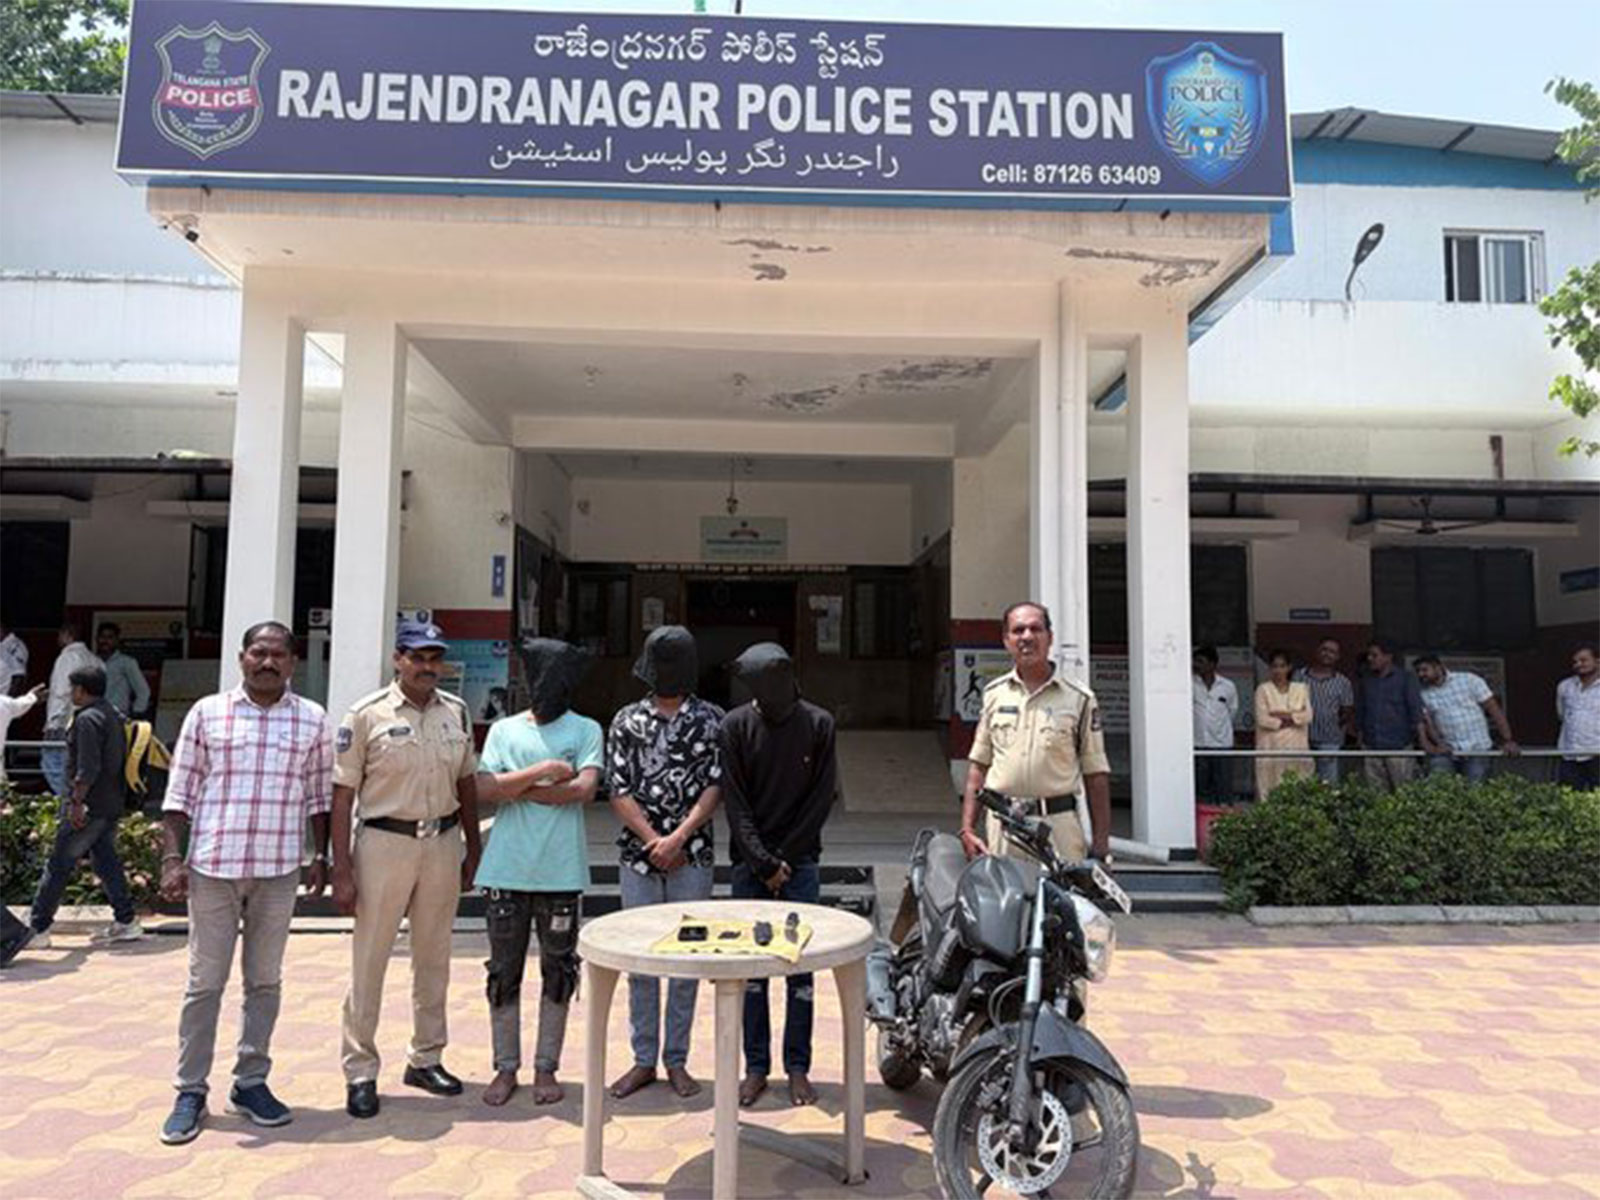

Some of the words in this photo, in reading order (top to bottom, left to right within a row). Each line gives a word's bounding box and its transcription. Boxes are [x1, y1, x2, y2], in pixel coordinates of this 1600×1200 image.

[721, 30, 797, 64] పోలీస్
[809, 31, 886, 79] స్టేషన్
[166, 85, 253, 108] POLICE
[277, 68, 721, 130] RAJENDRANAGAR
[737, 83, 913, 138] POLICE
[928, 88, 1134, 140] STATION
[1169, 86, 1242, 101] POLICE
[490, 136, 612, 170] اسٹیشن
[625, 139, 727, 175] پولیس
[737, 138, 786, 175] نگر
[796, 143, 899, 178] راجندر
[981, 163, 1028, 183] Cell:
[1033, 164, 1093, 184] 87126
[1098, 165, 1161, 186] 63409
